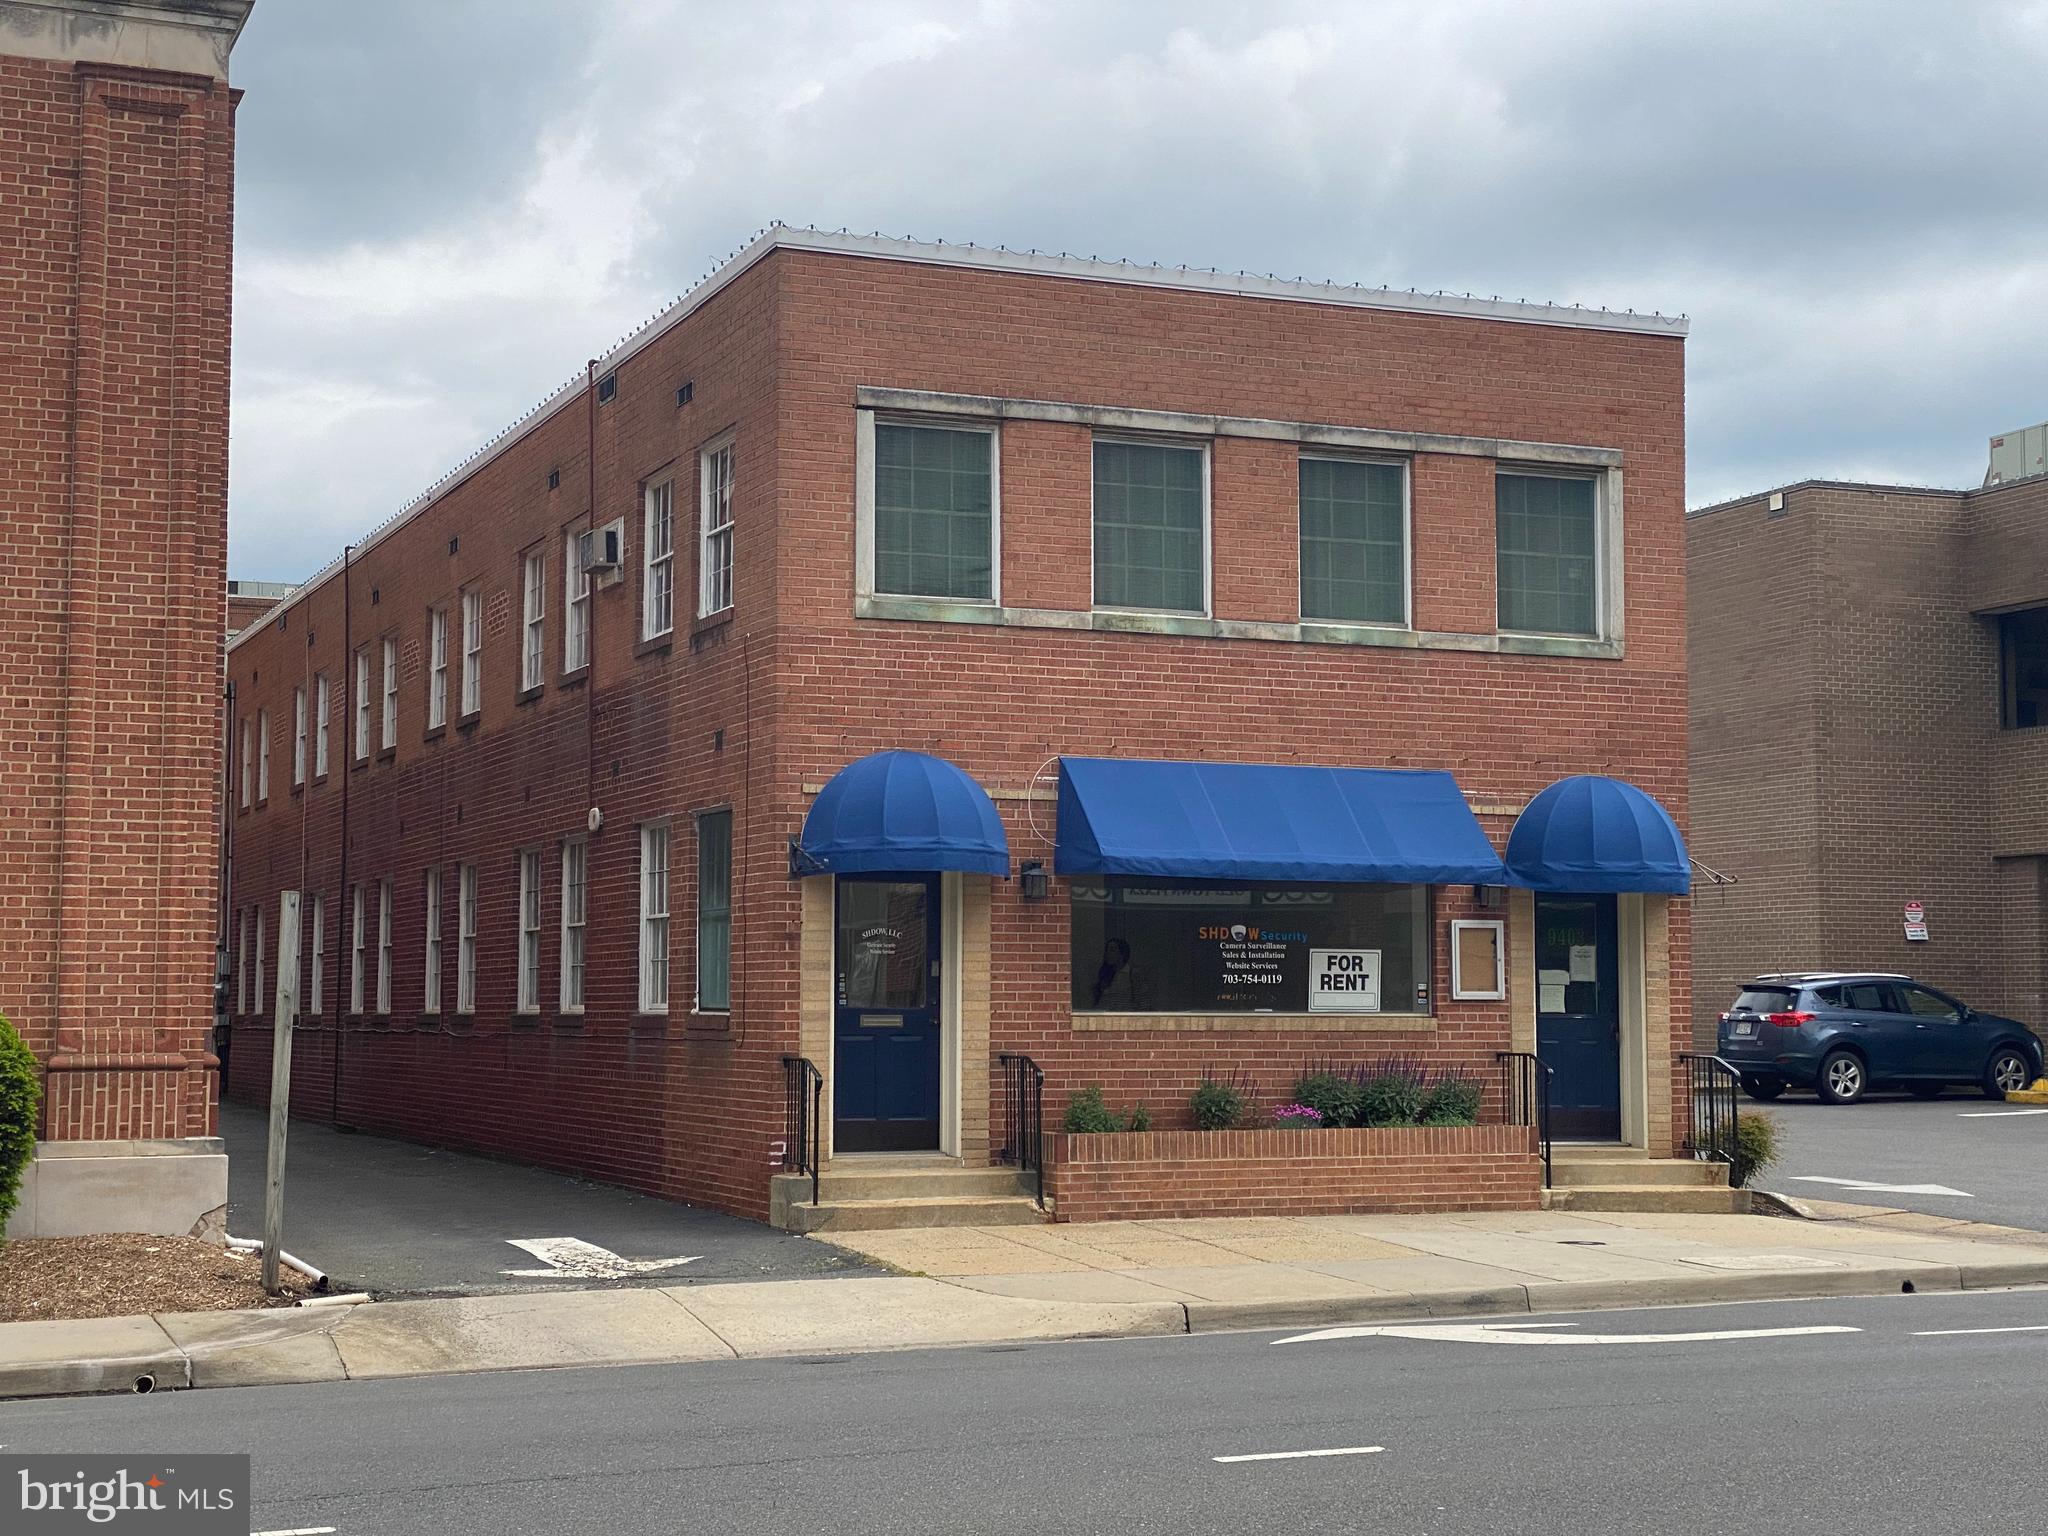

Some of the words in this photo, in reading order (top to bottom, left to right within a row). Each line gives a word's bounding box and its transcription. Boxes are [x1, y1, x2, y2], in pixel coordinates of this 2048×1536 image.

[1260, 931, 1308, 943] Security
[1247, 942, 1287, 950] Surveillance
[1222, 951, 1239, 959] Sales
[1240, 951, 1247, 959] &
[1248, 951, 1285, 959] Installation
[1225, 962, 1250, 970] Website
[1251, 962, 1278, 970] Services
[1327, 955, 1363, 972] FOR
[1222, 974, 1283, 984] 703-754-0119
[1320, 974, 1369, 991] RENT
